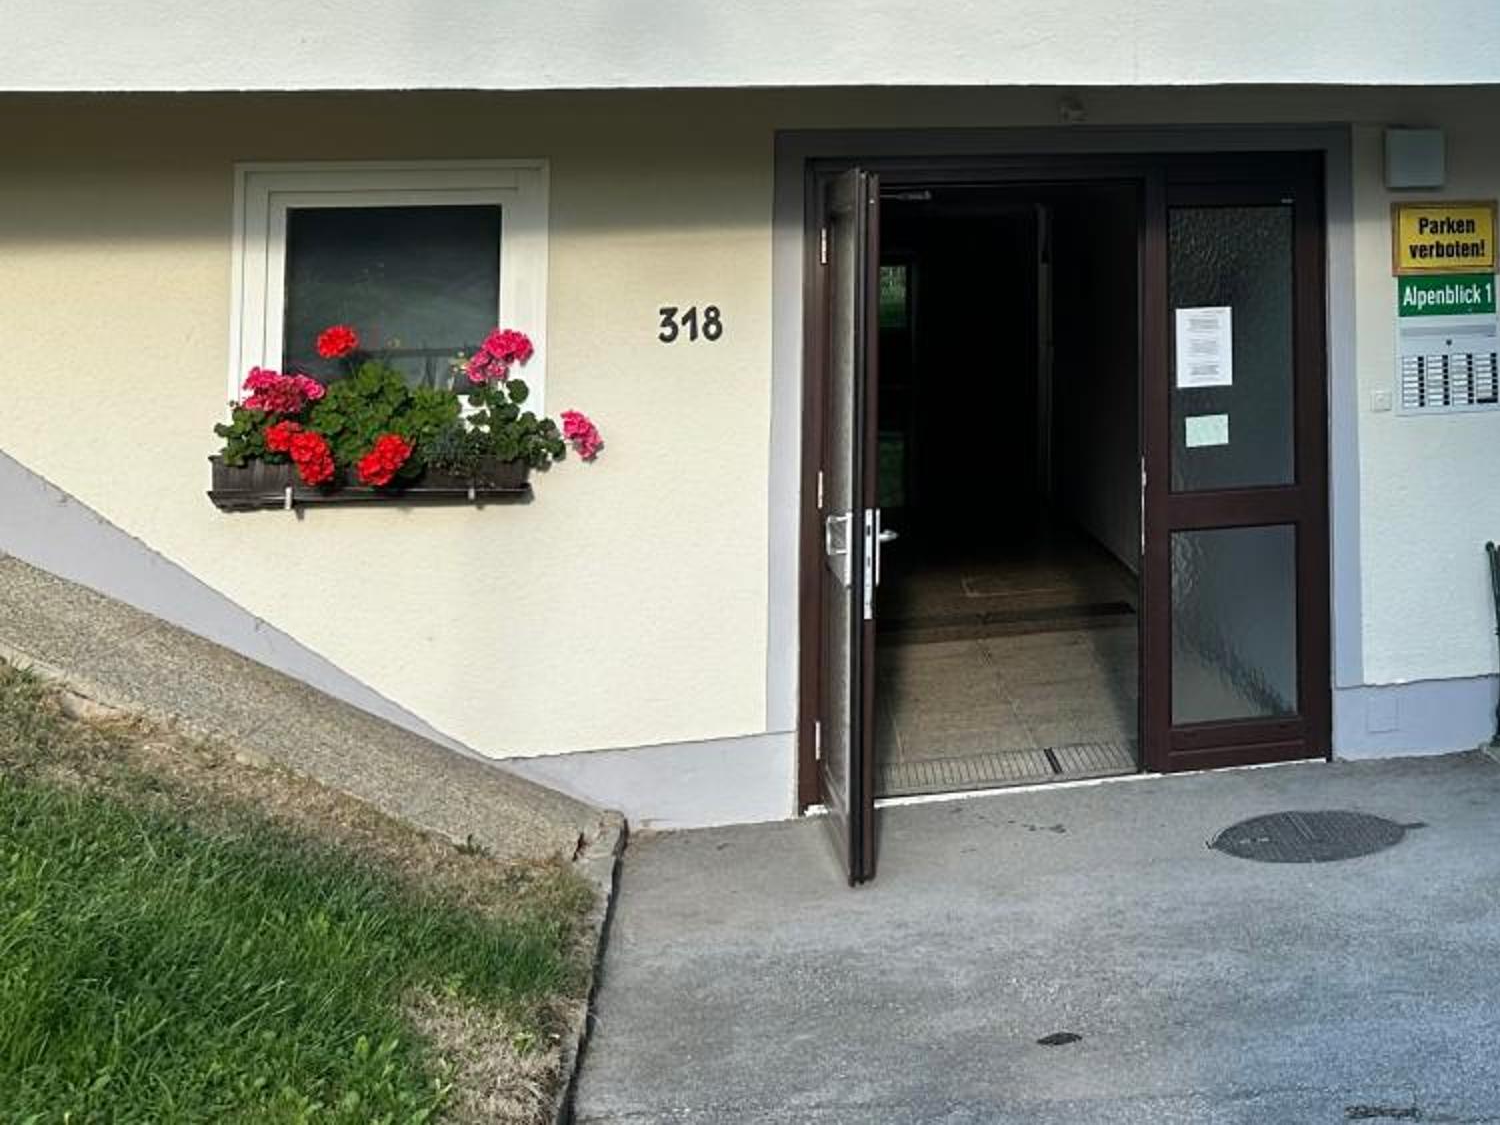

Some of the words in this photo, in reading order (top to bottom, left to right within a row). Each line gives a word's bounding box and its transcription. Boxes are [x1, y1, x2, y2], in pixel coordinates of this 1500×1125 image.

[1418, 216, 1475, 235] Parken
[1409, 238, 1485, 259] verboten!
[1403, 283, 1481, 310] Alpenblick
[1485, 282, 1492, 304] 1
[658, 305, 723, 343] 318
